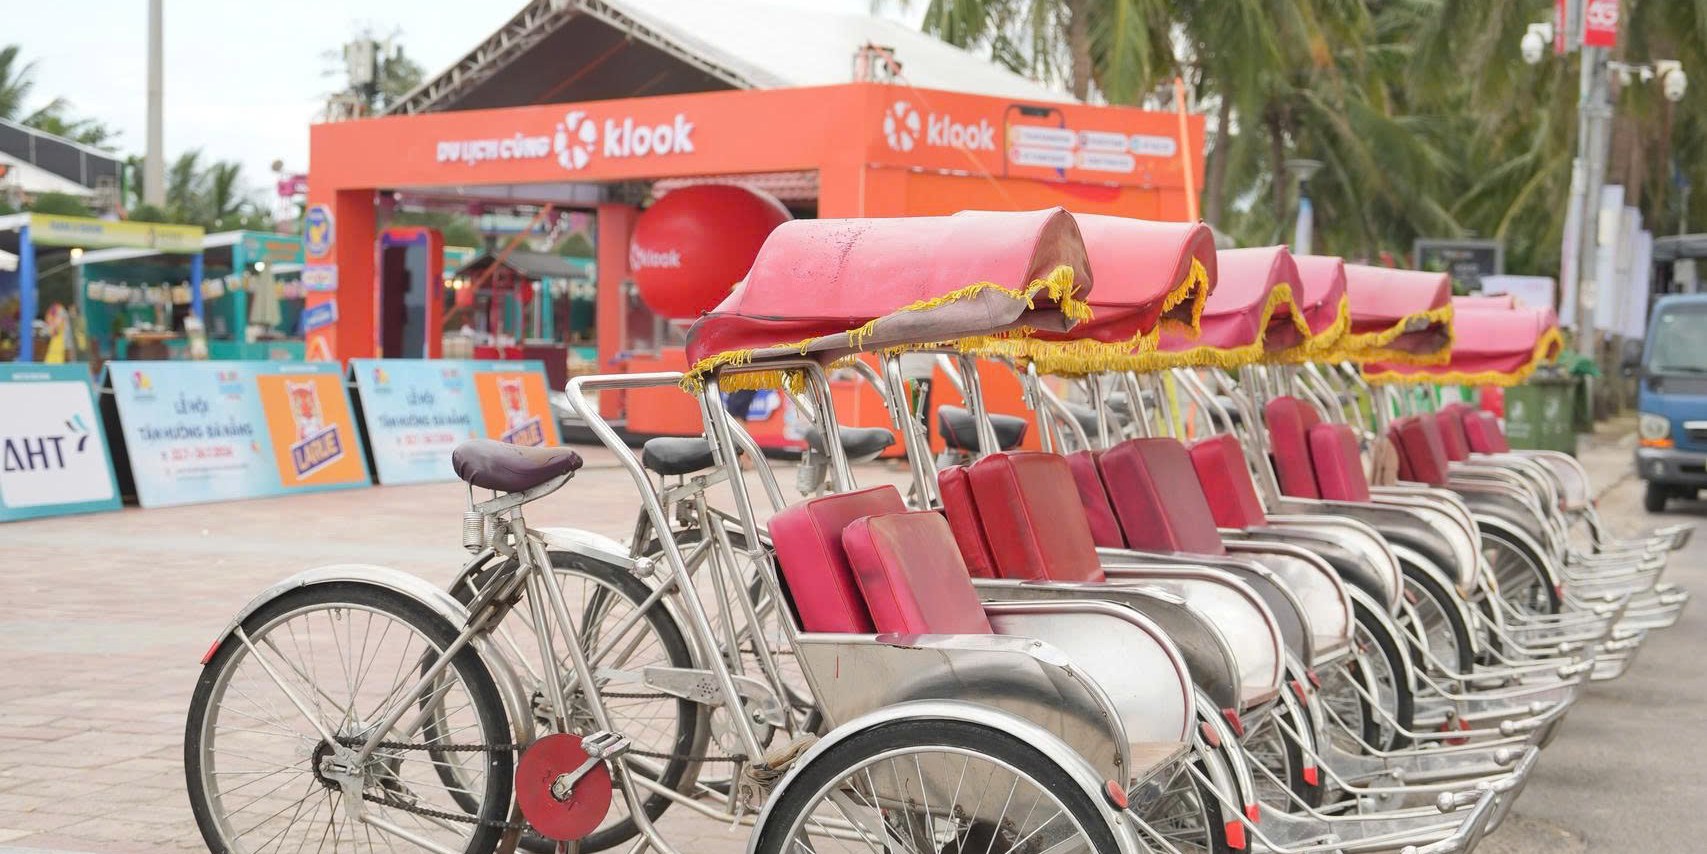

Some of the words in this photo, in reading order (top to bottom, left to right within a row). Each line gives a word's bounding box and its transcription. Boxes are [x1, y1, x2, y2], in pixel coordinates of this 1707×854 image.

[604, 113, 695, 157] klook
[928, 112, 996, 151] klook
[640, 247, 681, 269] klook
[293, 428, 342, 474] LARUE
